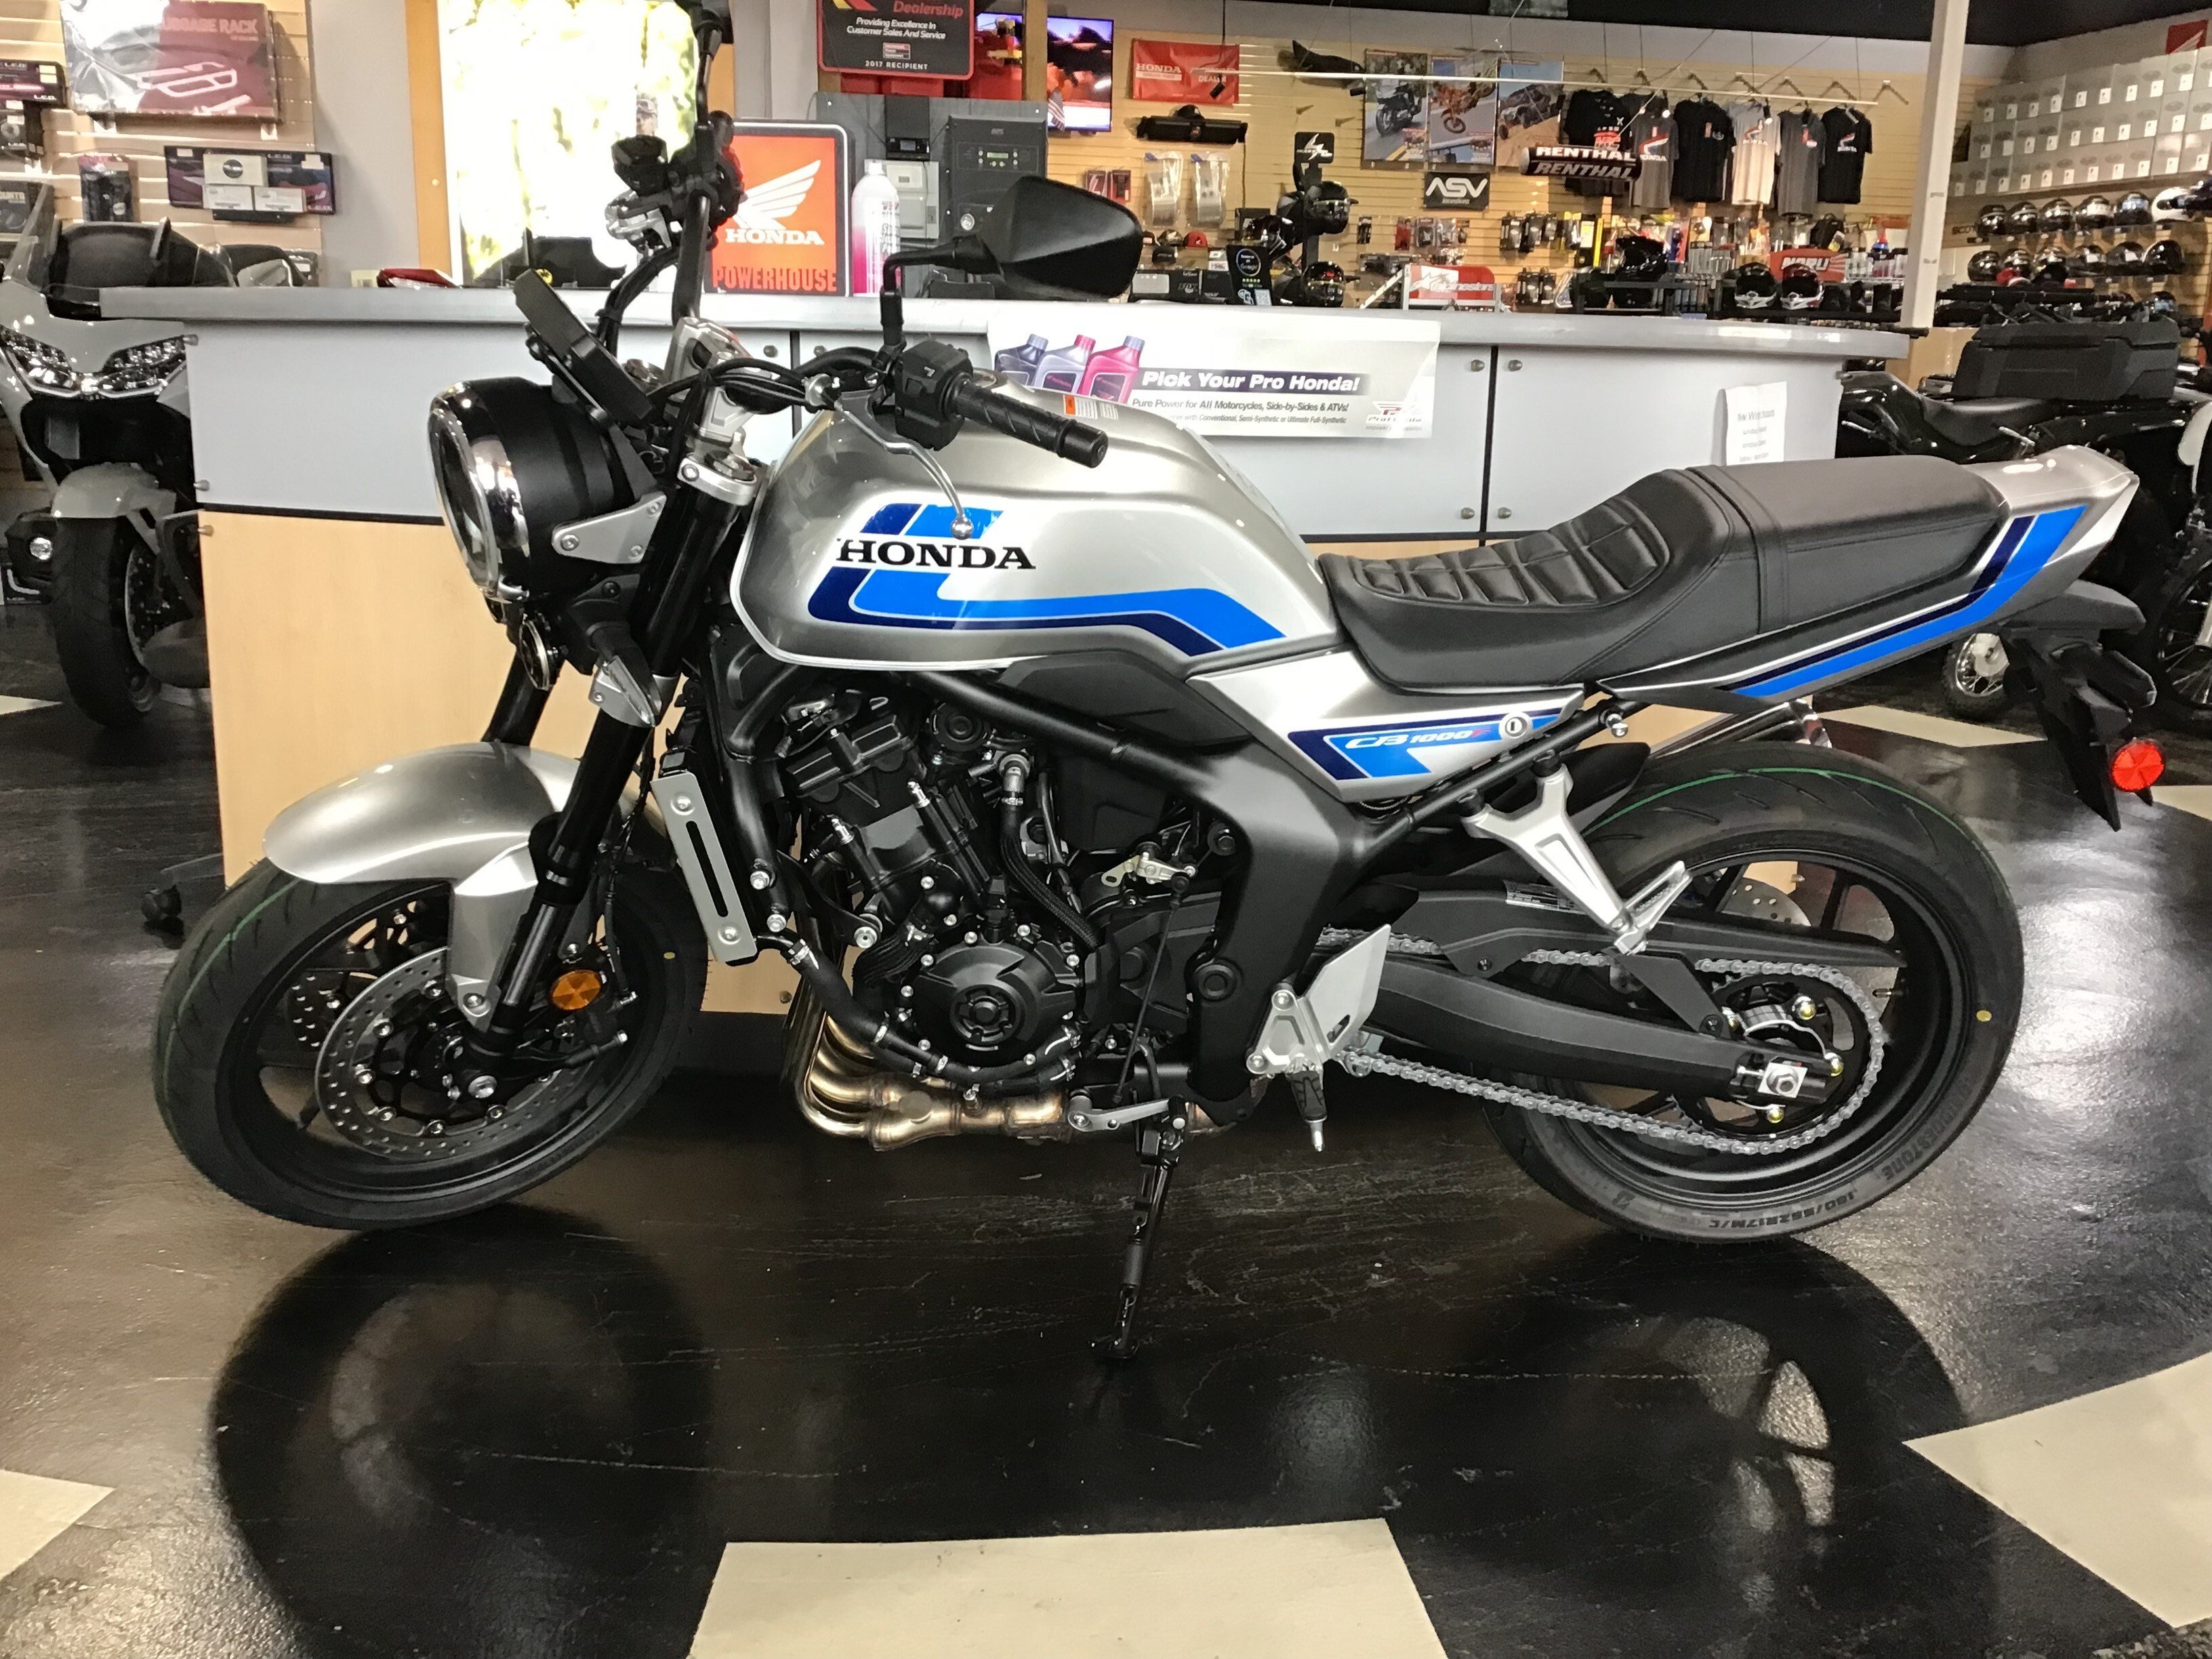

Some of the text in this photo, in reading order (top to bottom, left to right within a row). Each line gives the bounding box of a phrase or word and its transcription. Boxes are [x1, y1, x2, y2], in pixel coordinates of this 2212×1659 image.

[893, 1, 964, 20] Dealership
[219, 18, 258, 34] RACK
[856, 17, 937, 30] Providing Excellence In
[847, 26, 946, 39] Customer Sales And Service
[886, 61, 928, 70] RECIPIENT
[1136, 63, 1182, 74] HONDA
[1536, 146, 1637, 162] RENTHAL
[1533, 162, 1633, 180] RENTHAL
[1425, 176, 1488, 199] ASV
[725, 228, 825, 245] HONDA
[712, 266, 838, 291] POWERHOUSE
[1142, 371, 1361, 391] Pick Your Pro Honda!
[1132, 398, 1153, 407] Pure
[1155, 398, 1184, 408] Power
[1185, 399, 1197, 408] for
[1214, 400, 1264, 411] Motorcycles,
[1266, 401, 1318, 412] Side-by-Sides
[1319, 403, 1326, 411] &
[1327, 403, 1349, 411] ATVs!
[1239, 415, 1279, 424] Semi-Synthetic
[836, 538, 1036, 569] HONDA
